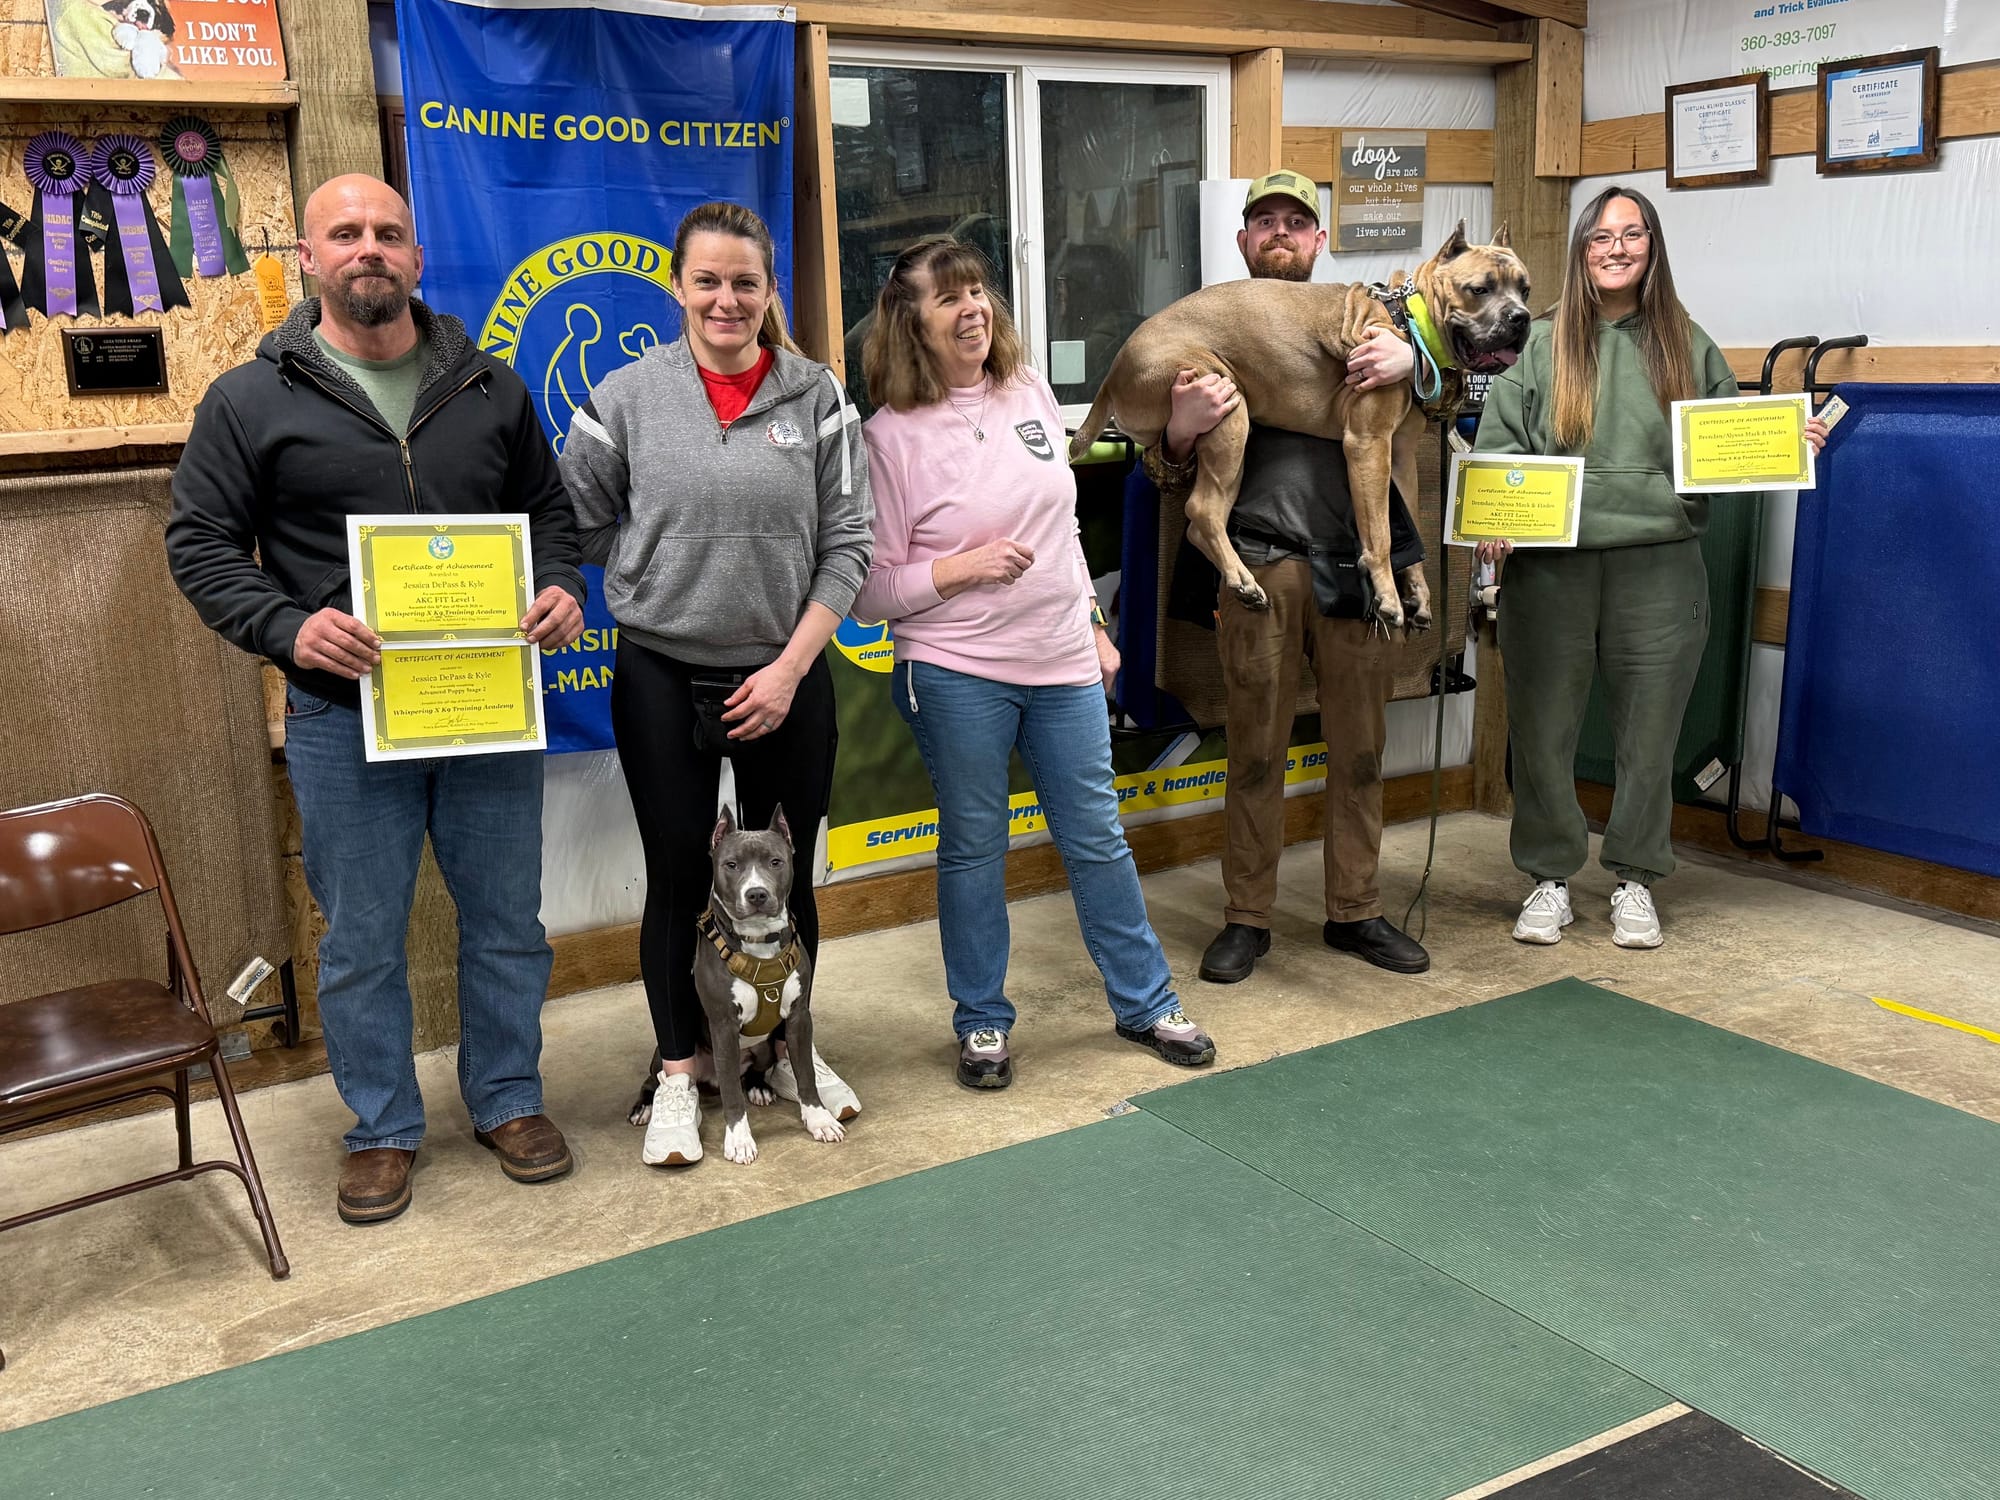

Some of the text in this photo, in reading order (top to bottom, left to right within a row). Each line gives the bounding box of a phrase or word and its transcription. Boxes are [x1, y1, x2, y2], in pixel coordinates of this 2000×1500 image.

[1754, 7, 1775, 18] and
[1778, 2, 1804, 14] Trick
[185, 21, 257, 42] I DON'T
[1740, 23, 1837, 52] 360-393-7097
[176, 45, 277, 67] LIKE YOU.
[1852, 79, 1899, 93] CERTIFICATE
[420, 101, 545, 140] CANINE
[553, 115, 650, 143] GOOD
[1351, 136, 1401, 181] dogs
[1386, 166, 1418, 177] are not
[1349, 182, 1418, 193] our whole lives
[1365, 196, 1402, 208] but they
[1363, 211, 1401, 221] make our
[1356, 226, 1406, 237] lives whole
[546, 239, 661, 277] GOOD
[1472, 375, 1487, 383] DOG
[468, 580, 485, 589] Kyle
[385, 610, 425, 619] Whispering
[445, 608, 475, 617] Training
[475, 608, 507, 616] Academy
[394, 651, 507, 663] CERTIFICATE OF ACHIEVEMENT
[411, 671, 492, 683] Jessica DePass & Kyle
[393, 707, 433, 717] Whispering
[452, 704, 482, 713] Training
[483, 702, 514, 711] Academy
[866, 821, 940, 847] Servin
[1144, 780, 1157, 795] &
